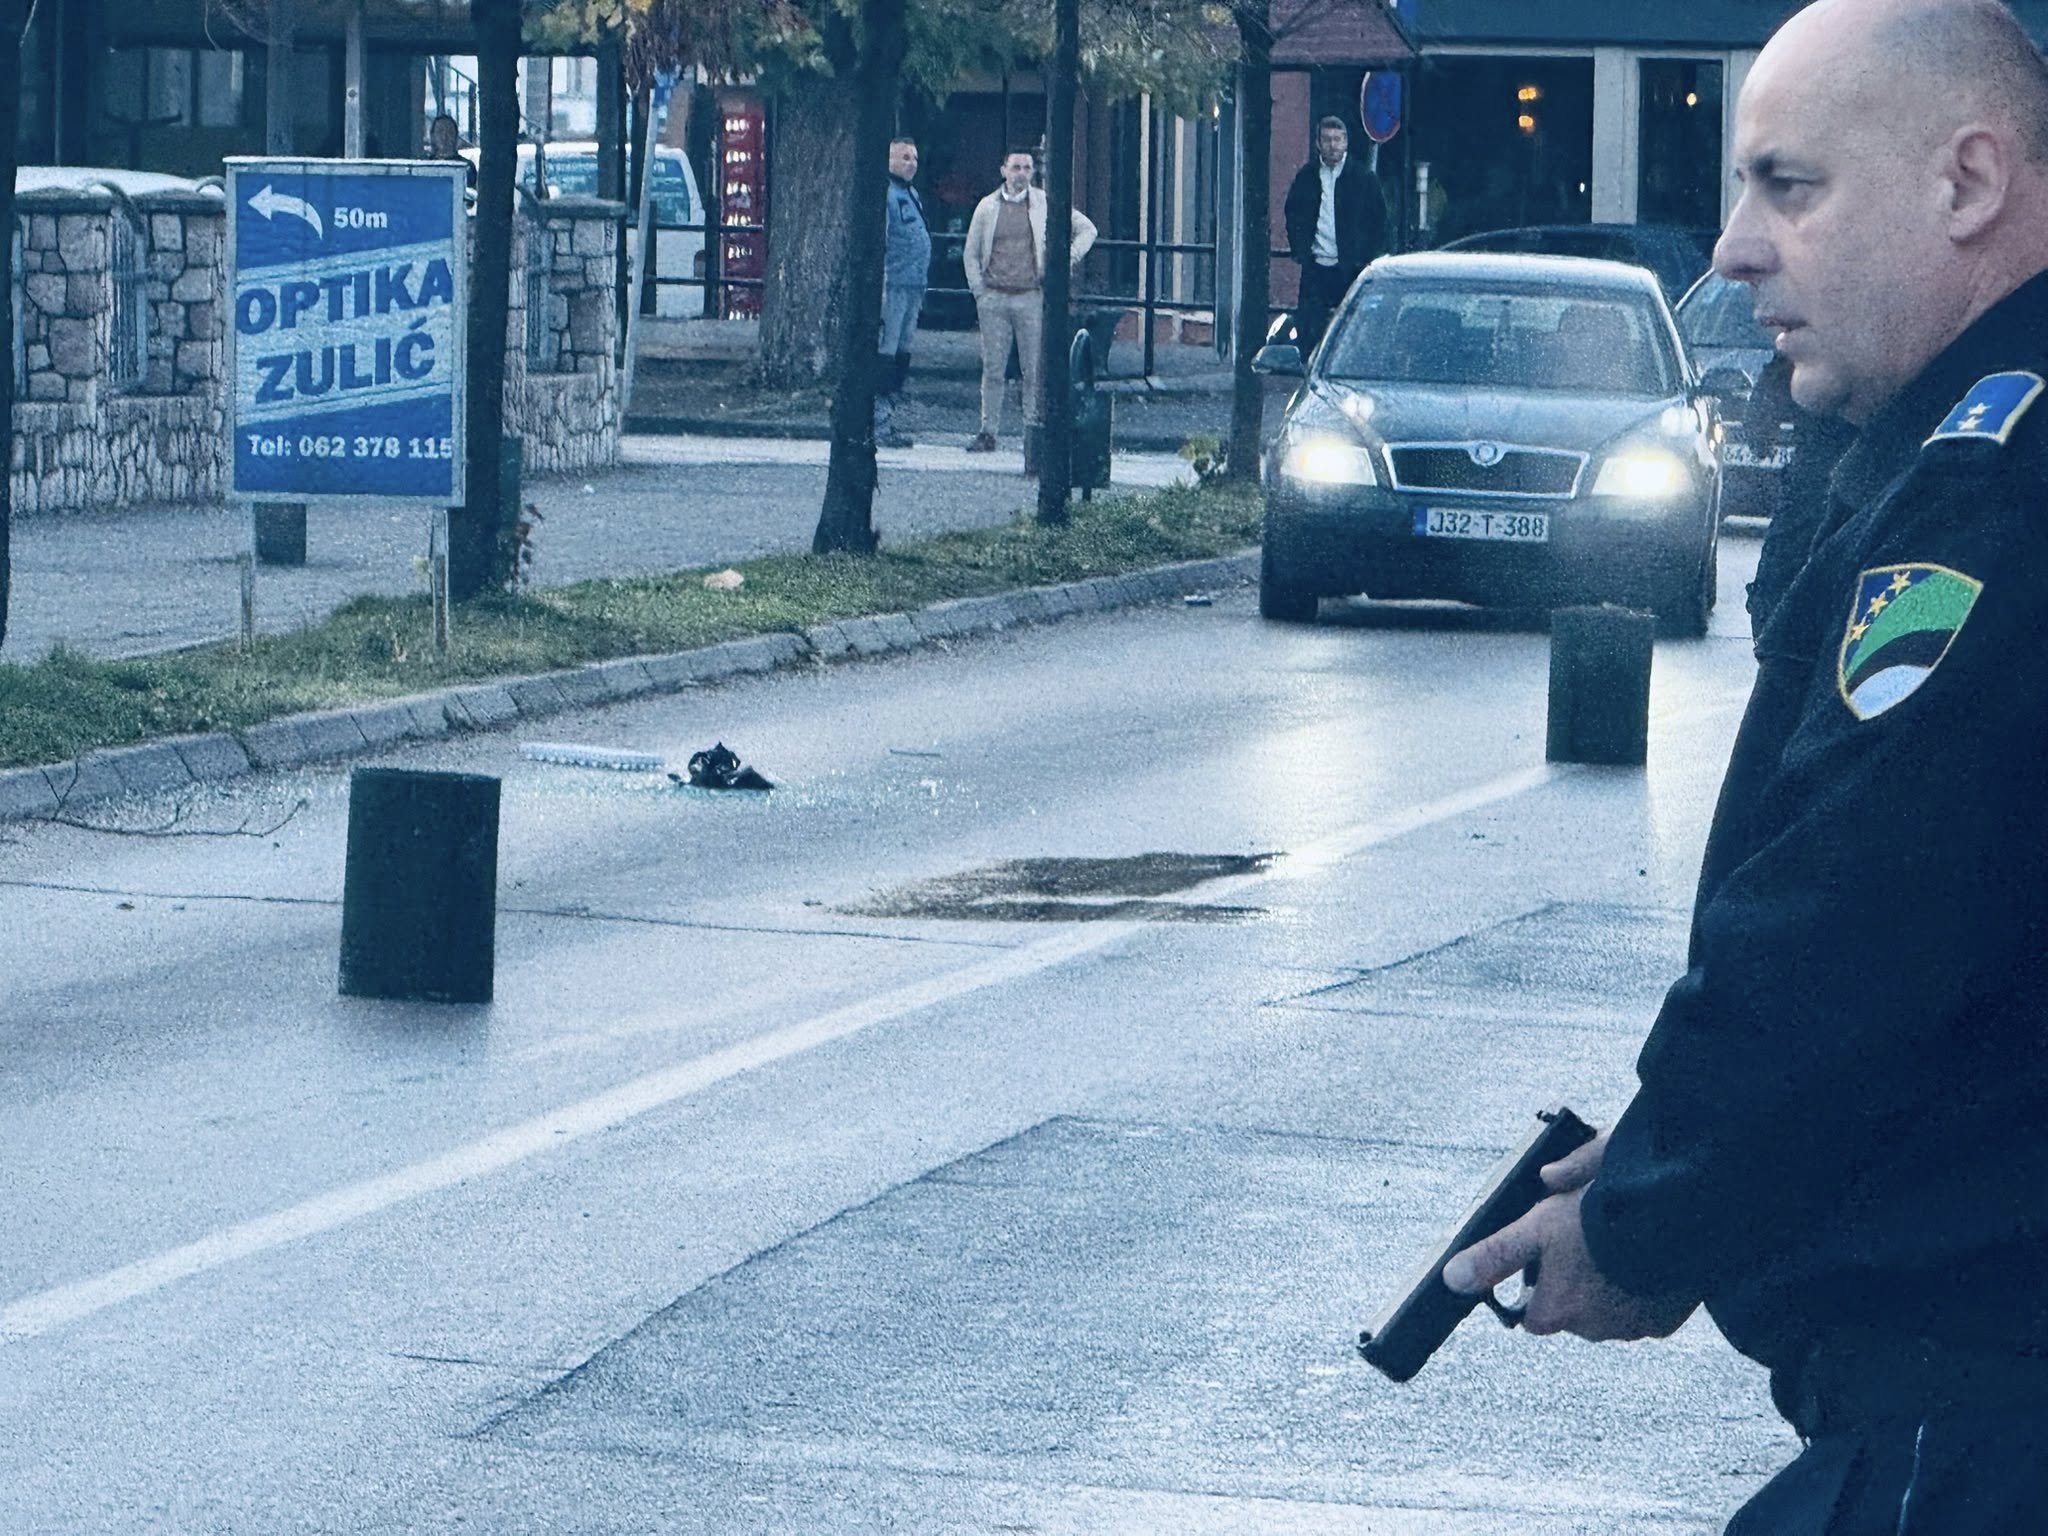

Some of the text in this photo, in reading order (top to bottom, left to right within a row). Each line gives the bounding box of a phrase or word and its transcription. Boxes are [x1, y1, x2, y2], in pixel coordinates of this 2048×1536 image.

[334, 207, 388, 229] 50m
[236, 258, 453, 335] OPTIKA
[256, 316, 435, 404] ZULIĆ
[248, 434, 452, 459] Tel: 062 378 115
